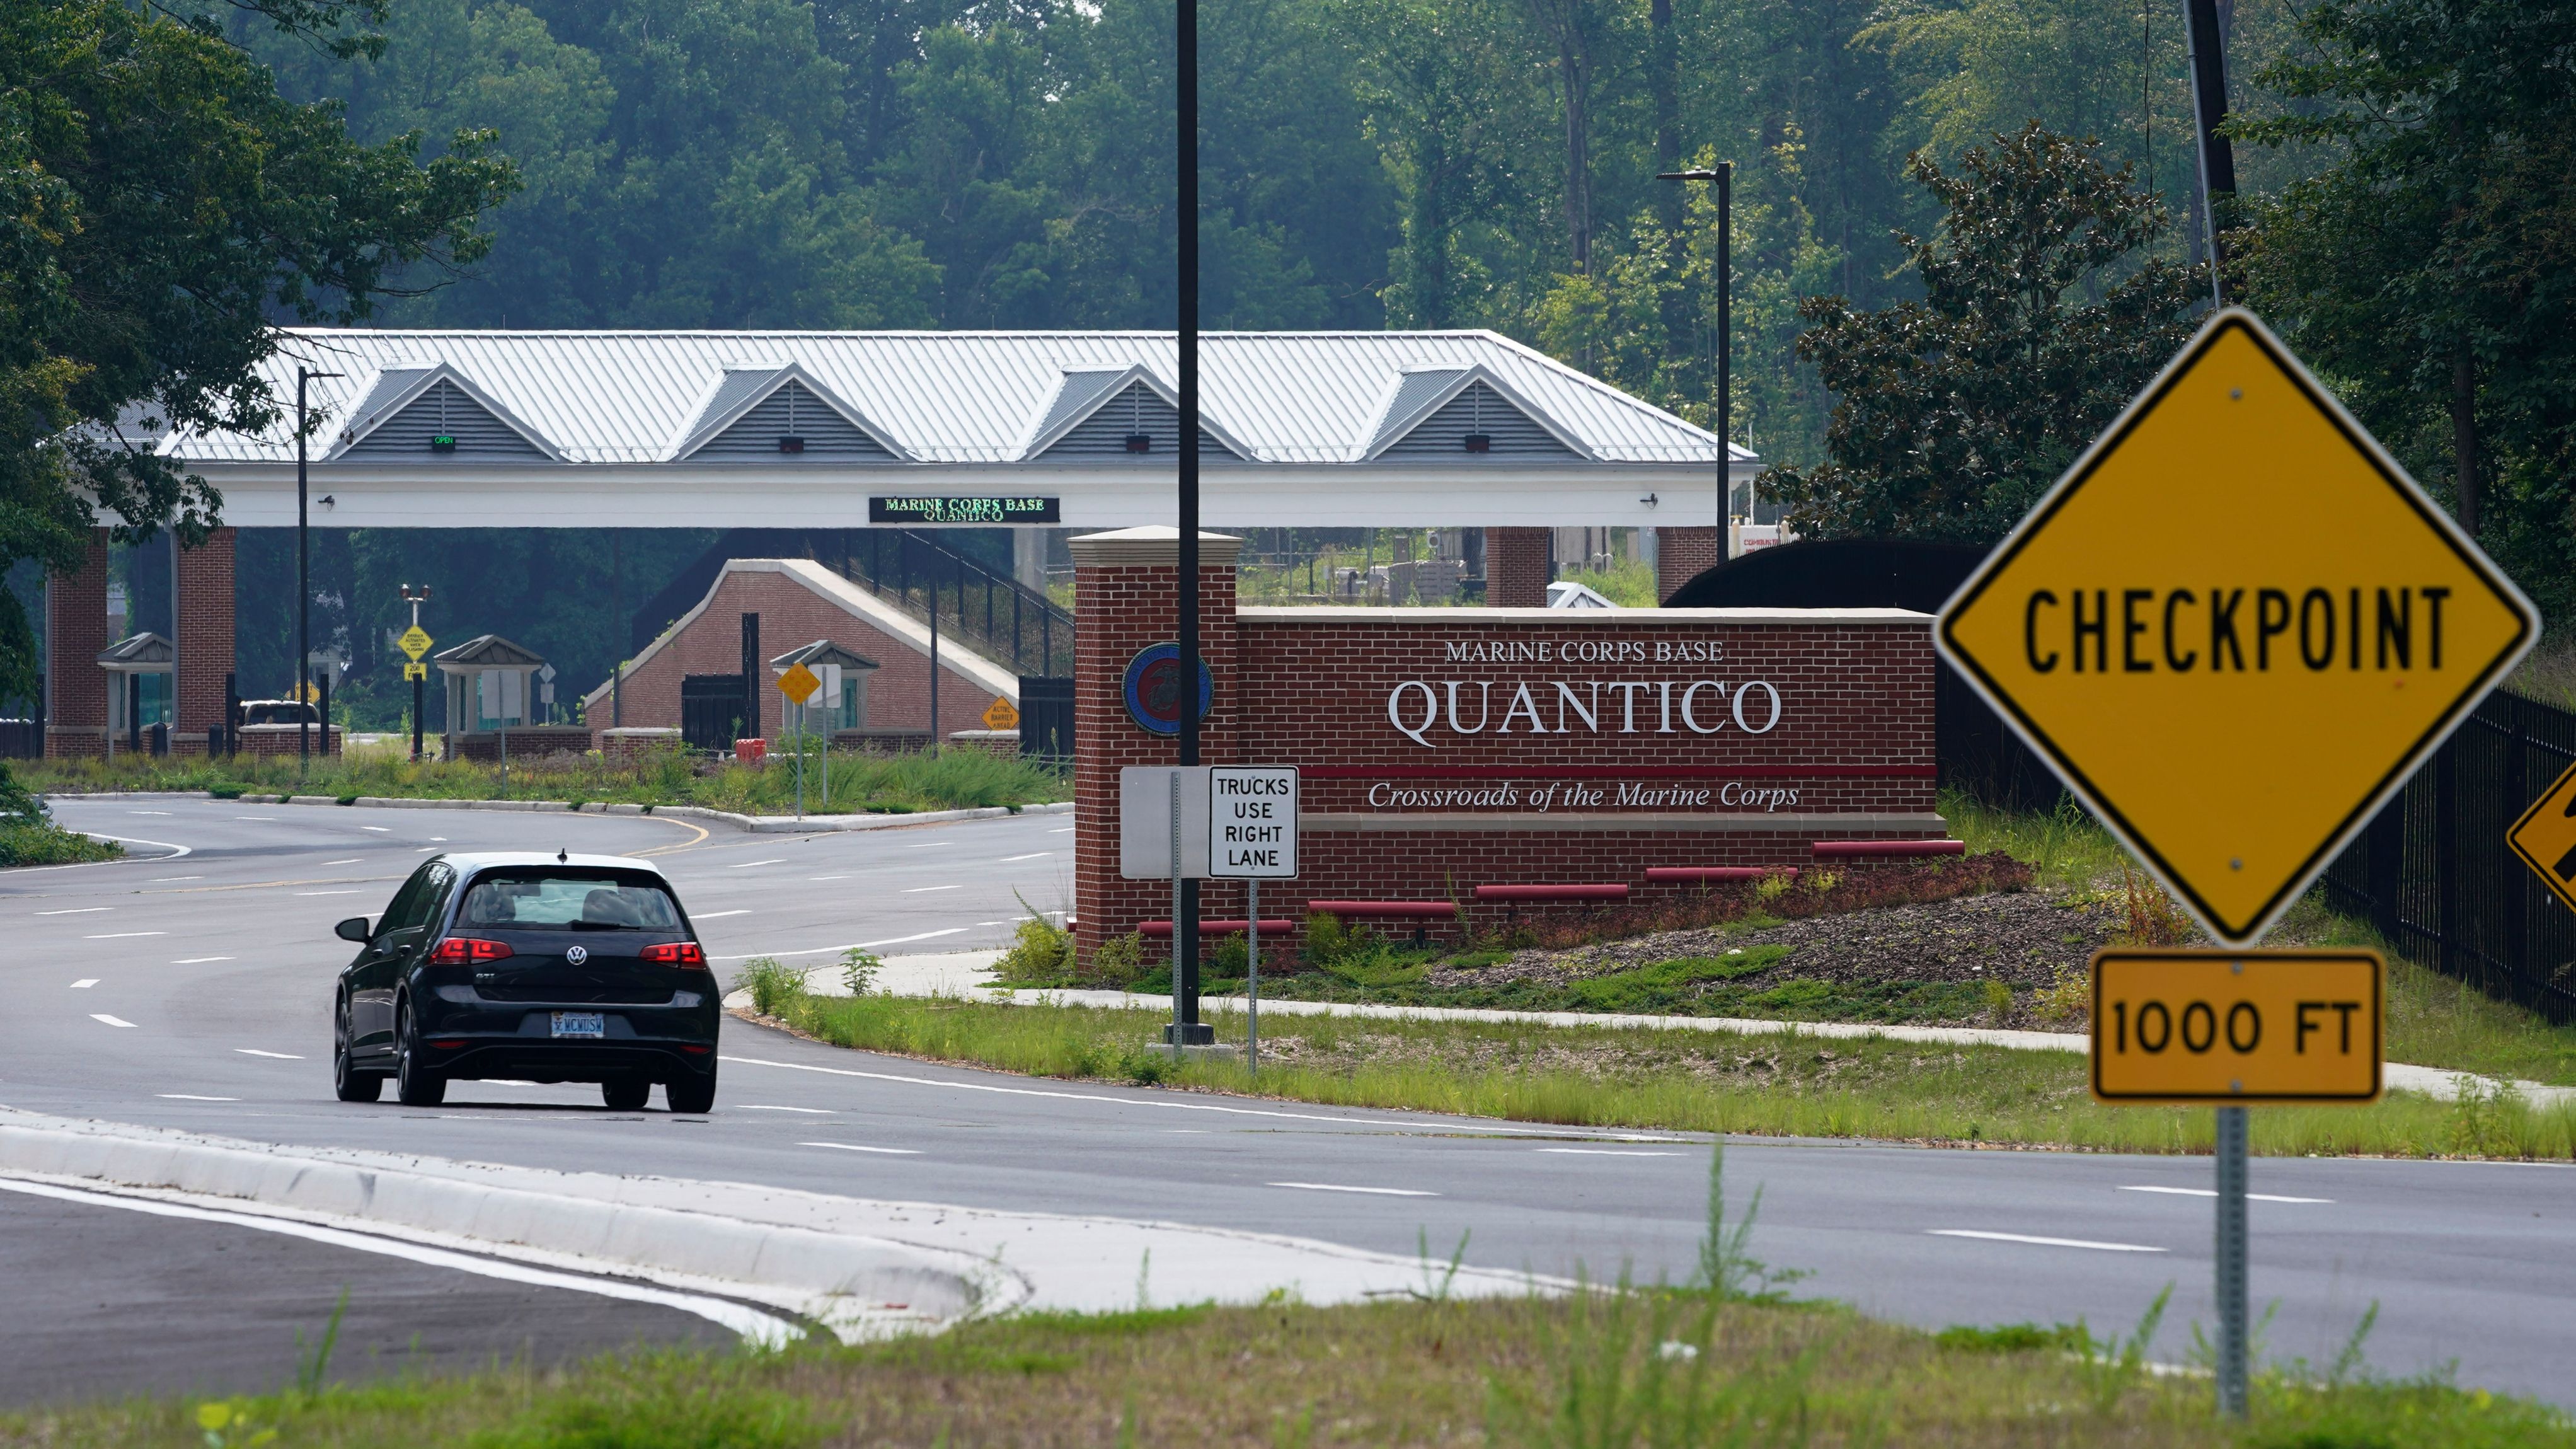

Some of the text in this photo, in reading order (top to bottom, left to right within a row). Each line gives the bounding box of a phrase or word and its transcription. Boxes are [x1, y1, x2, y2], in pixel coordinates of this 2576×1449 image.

[885, 499, 1044, 511] MARINE CORPS BASE
[924, 509, 1004, 522] QUANTICO
[2024, 586, 2452, 674] CHECKPOINT
[1446, 642, 1723, 662] MARINE CORPS BASE
[1388, 680, 1782, 748] QUANTICO
[1217, 778, 1289, 795] TRUCKS
[1368, 782, 1799, 812] Crossroads of the Marine Corps
[1234, 802, 1273, 819] USE
[1226, 826, 1283, 843] RIGHT
[1229, 850, 1279, 867] LANE
[2113, 1000, 2361, 1054] 1000 FT
